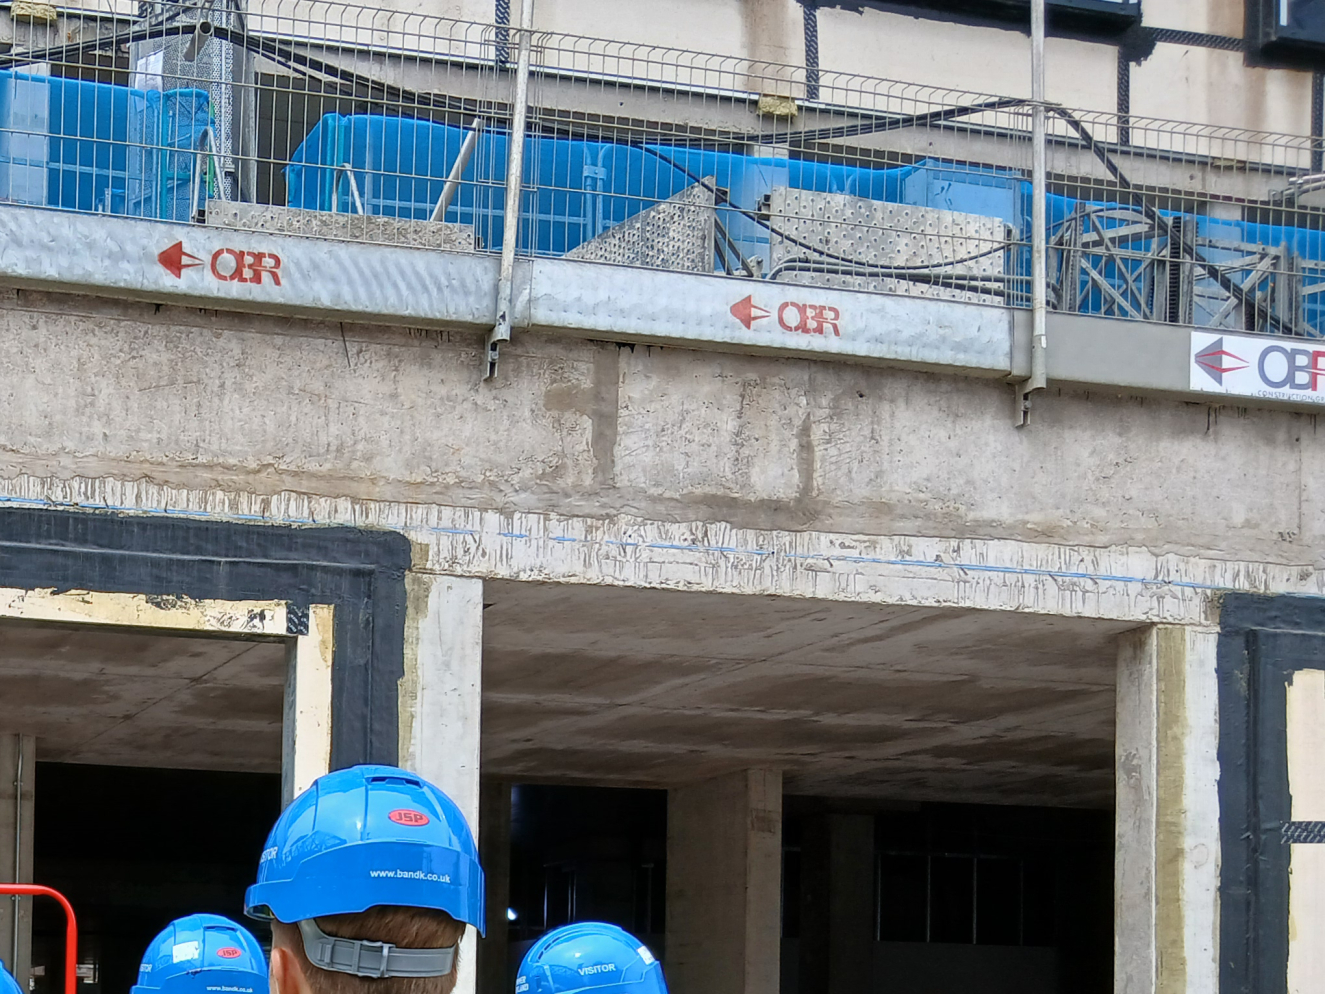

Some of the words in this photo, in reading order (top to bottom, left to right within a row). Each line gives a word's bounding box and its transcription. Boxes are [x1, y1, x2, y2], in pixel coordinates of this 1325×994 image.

[395, 812, 424, 823] JSP
[370, 869, 450, 883] www.bandk.co.uk
[578, 963, 616, 976] VISITOR
